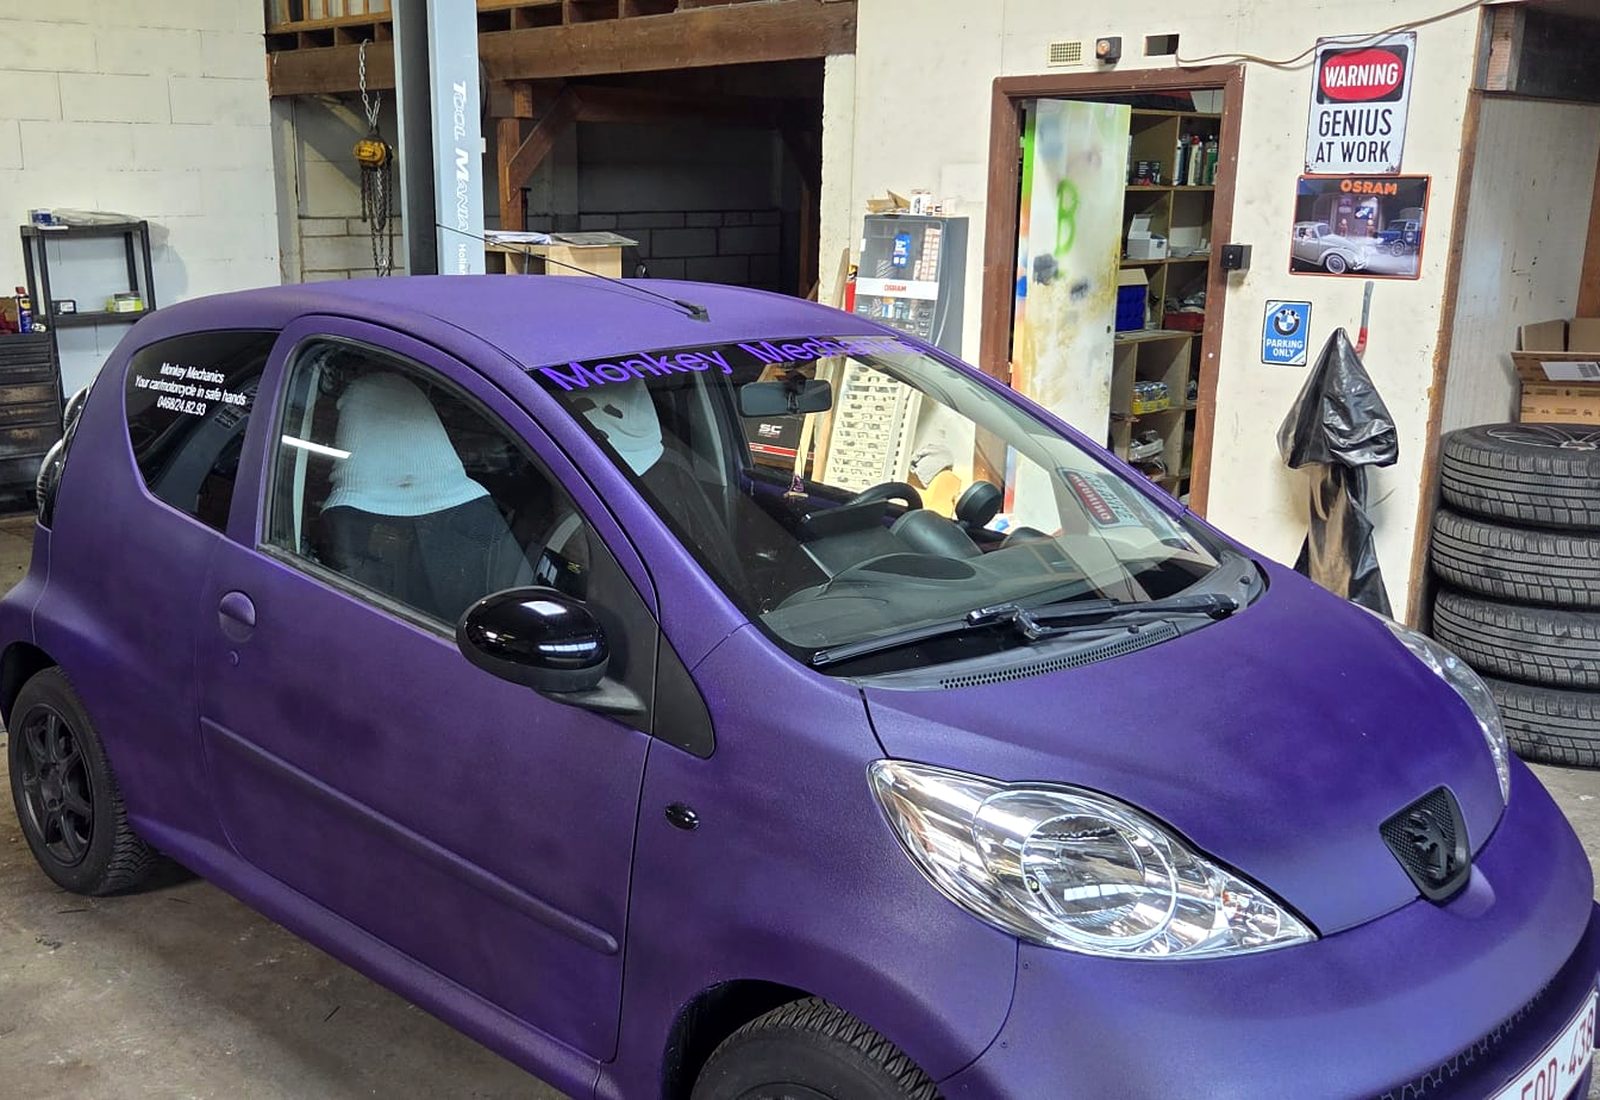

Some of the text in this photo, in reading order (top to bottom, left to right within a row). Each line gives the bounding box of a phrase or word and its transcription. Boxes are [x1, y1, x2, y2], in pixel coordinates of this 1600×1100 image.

[1325, 63, 1398, 88] WARNING
[453, 81, 467, 141] TOOL
[1319, 108, 1392, 137] GENIUS
[1315, 140, 1391, 163] AT WORK
[1340, 179, 1398, 195] OSRAM
[1266, 338, 1304, 349] PARKING
[1272, 348, 1295, 357] ONLY
[160, 363, 224, 383] Monkey Mechanics
[539, 348, 731, 392] Monkey
[135, 375, 149, 387] Your
[196, 385, 204, 398] in
[205, 388, 221, 401] safe
[221, 389, 247, 406] hands
